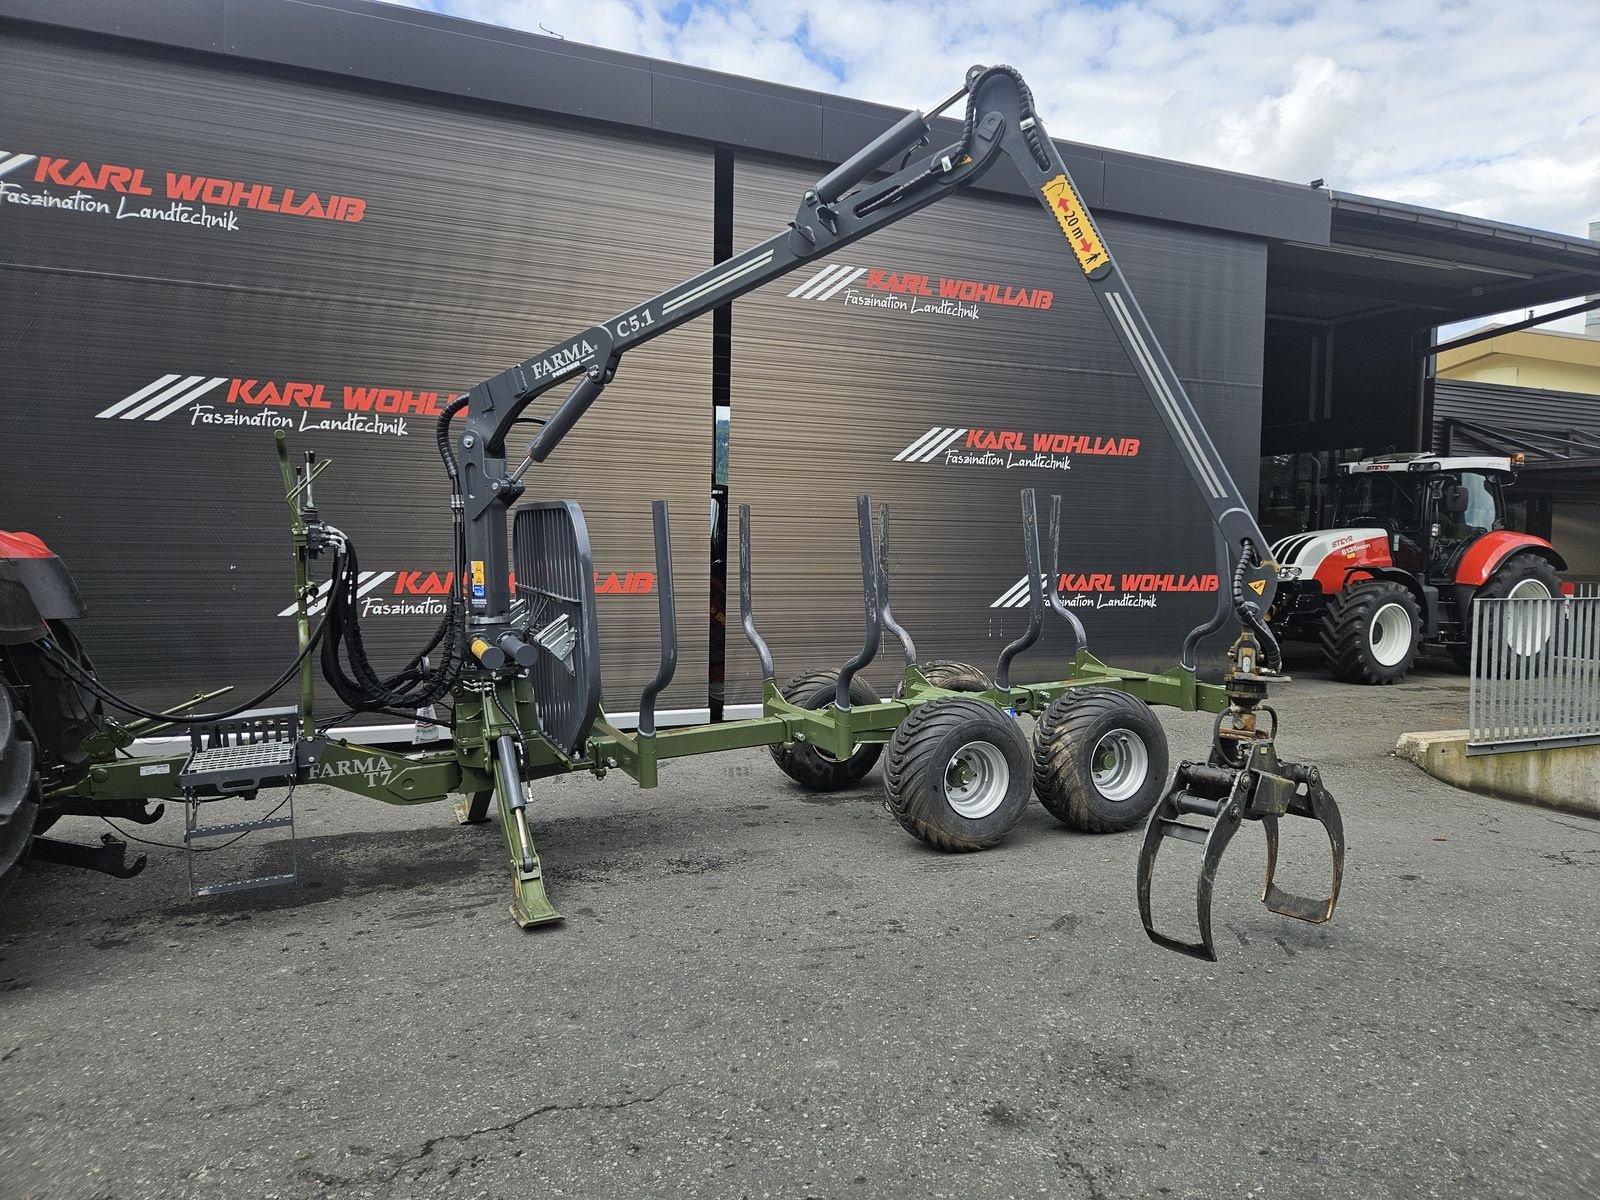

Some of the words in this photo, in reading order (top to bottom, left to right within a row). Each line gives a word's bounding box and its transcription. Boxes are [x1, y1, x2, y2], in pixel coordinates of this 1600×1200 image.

[33, 156, 153, 196] KARL
[0, 181, 110, 214] Faszination
[116, 196, 240, 231] Landtechnik
[1064, 210, 1079, 227] 20
[1072, 227, 1083, 240] m
[865, 268, 933, 296] KARL
[843, 288, 907, 310] Faszination
[910, 296, 980, 320] Landtechnik
[531, 339, 595, 380] FARMA
[226, 378, 332, 409] KARL
[343, 386, 469, 417] WOHL
[188, 403, 293, 428] Faszination
[298, 411, 408, 436] Landtechnik
[965, 429, 1027, 451] KARL
[945, 448, 1004, 466] Faszination
[1006, 452, 1071, 470] Landtechnik
[1331, 535, 1353, 548] STEYR
[1057, 574, 1116, 592] KARL
[1096, 592, 1157, 610] Landtechnik
[308, 756, 393, 780] FARMA
[363, 770, 393, 788] T7
